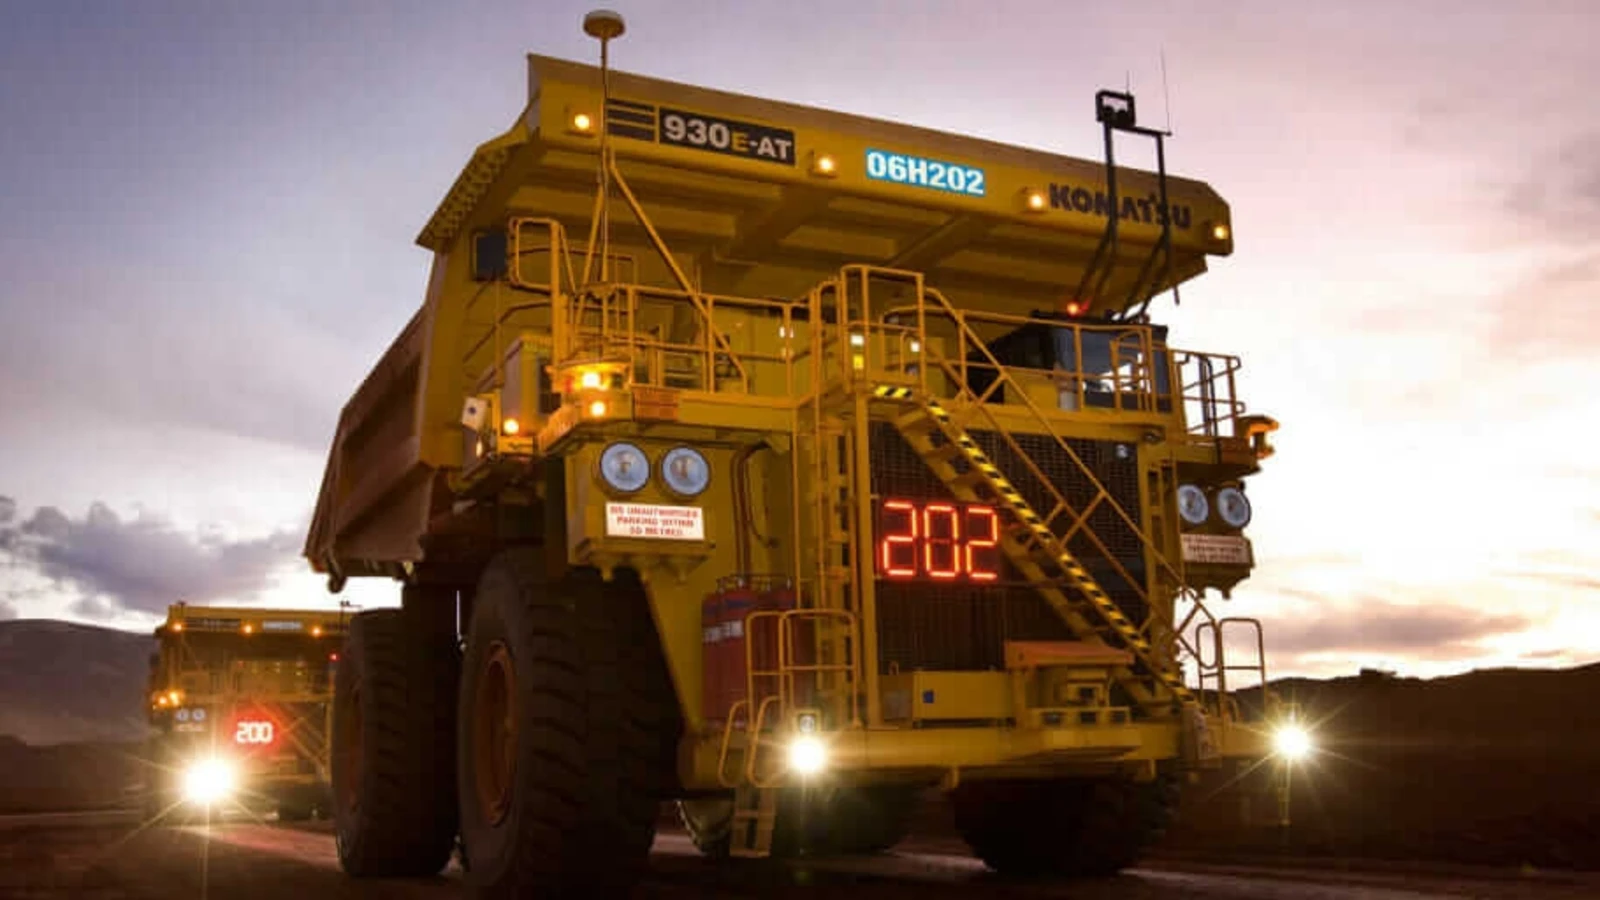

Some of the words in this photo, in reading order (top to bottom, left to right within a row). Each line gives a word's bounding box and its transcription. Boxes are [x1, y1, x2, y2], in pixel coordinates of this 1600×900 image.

[664, 114, 793, 160] 930E-AT
[867, 151, 984, 195] 06H202
[884, 501, 998, 578] 202
[235, 721, 274, 743] 200
